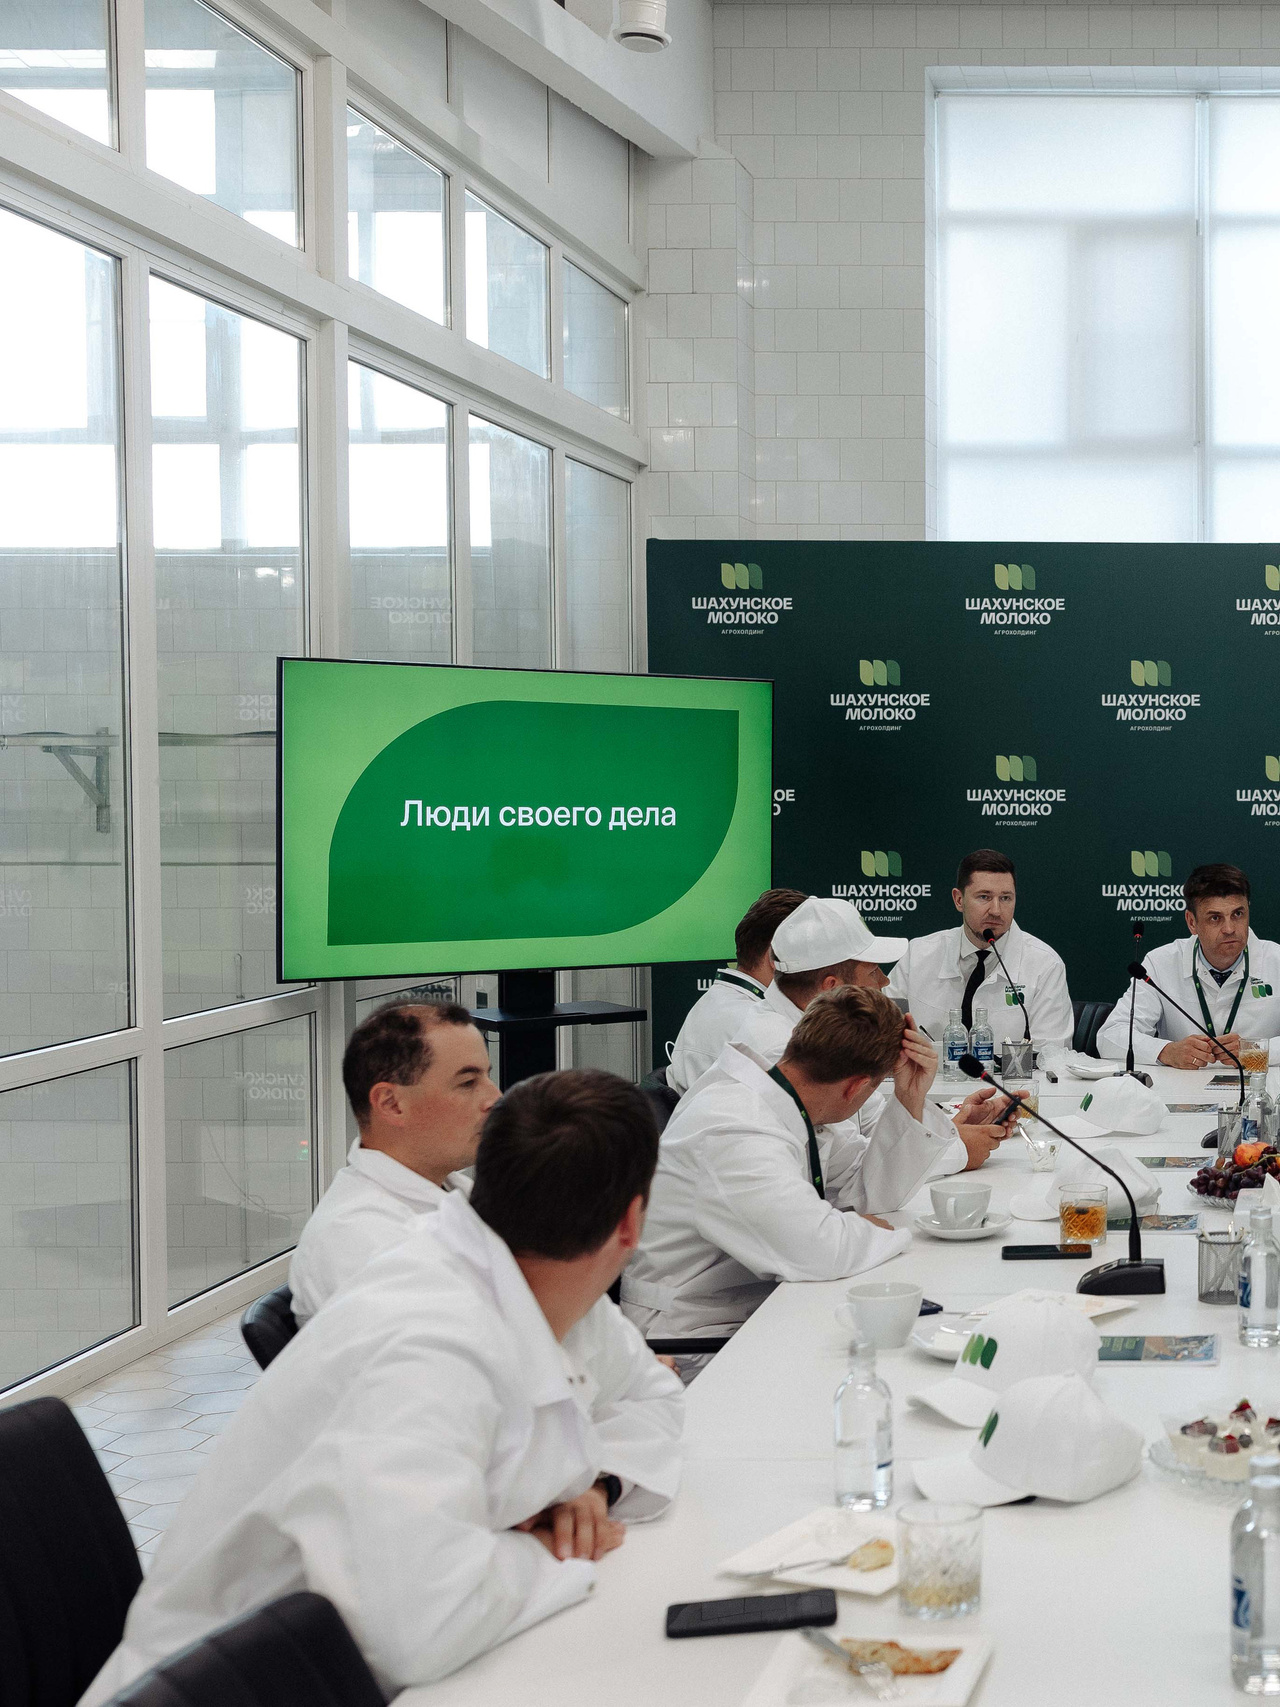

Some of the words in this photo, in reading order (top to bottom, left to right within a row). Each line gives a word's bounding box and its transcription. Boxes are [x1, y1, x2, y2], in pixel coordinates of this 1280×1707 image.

[691, 596, 793, 610] ШАХУНСКОЕ
[965, 597, 1066, 611] ШАХУНСКОЕ
[707, 611, 779, 625] МОЛОКО
[980, 611, 1052, 625] МОЛОКО
[830, 693, 931, 707] ШАХУНСКОЕ
[1101, 693, 1201, 707] ШАХУНСКОЕ
[845, 707, 916, 721] МОЛОКО
[1115, 708, 1187, 721] МОЛОКО
[966, 788, 1067, 802] ШАХУНСКОЕ
[400, 800, 490, 831] Люди
[499, 806, 602, 827] своего
[608, 806, 677, 831] дела
[981, 803, 1053, 816] МОЛОКО
[831, 884, 932, 897] ШАХУНСКОЕ
[1101, 884, 1184, 897] ШАХУНСК
[1116, 898, 1187, 912] МОЛОКО
